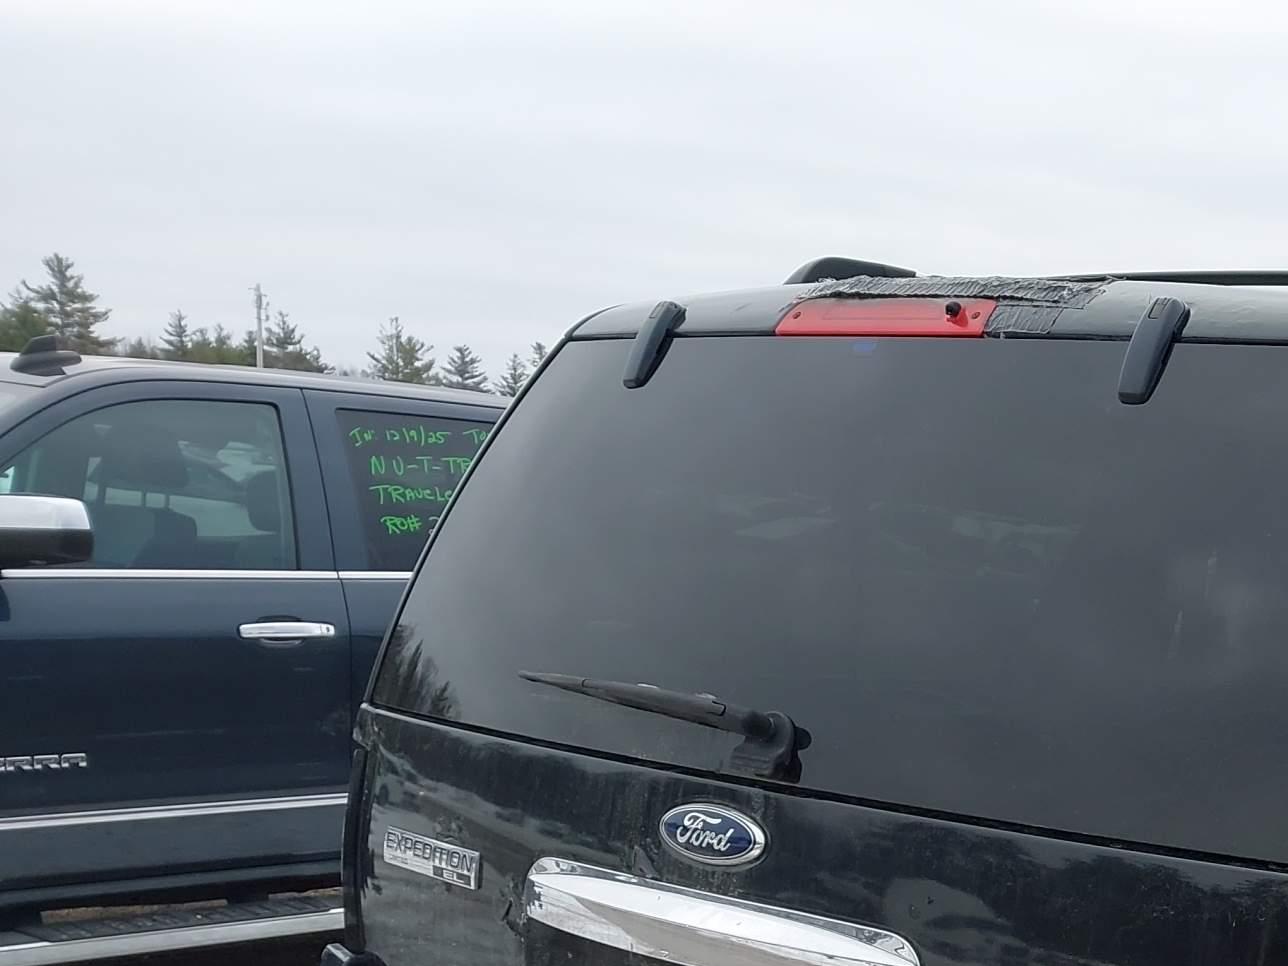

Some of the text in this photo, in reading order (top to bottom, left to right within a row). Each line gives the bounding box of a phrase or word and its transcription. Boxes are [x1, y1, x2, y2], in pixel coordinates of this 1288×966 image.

[0, 753, 87, 771] RRA
[676, 812, 735, 851] Ford
[386, 831, 475, 873] EXPEDITION
